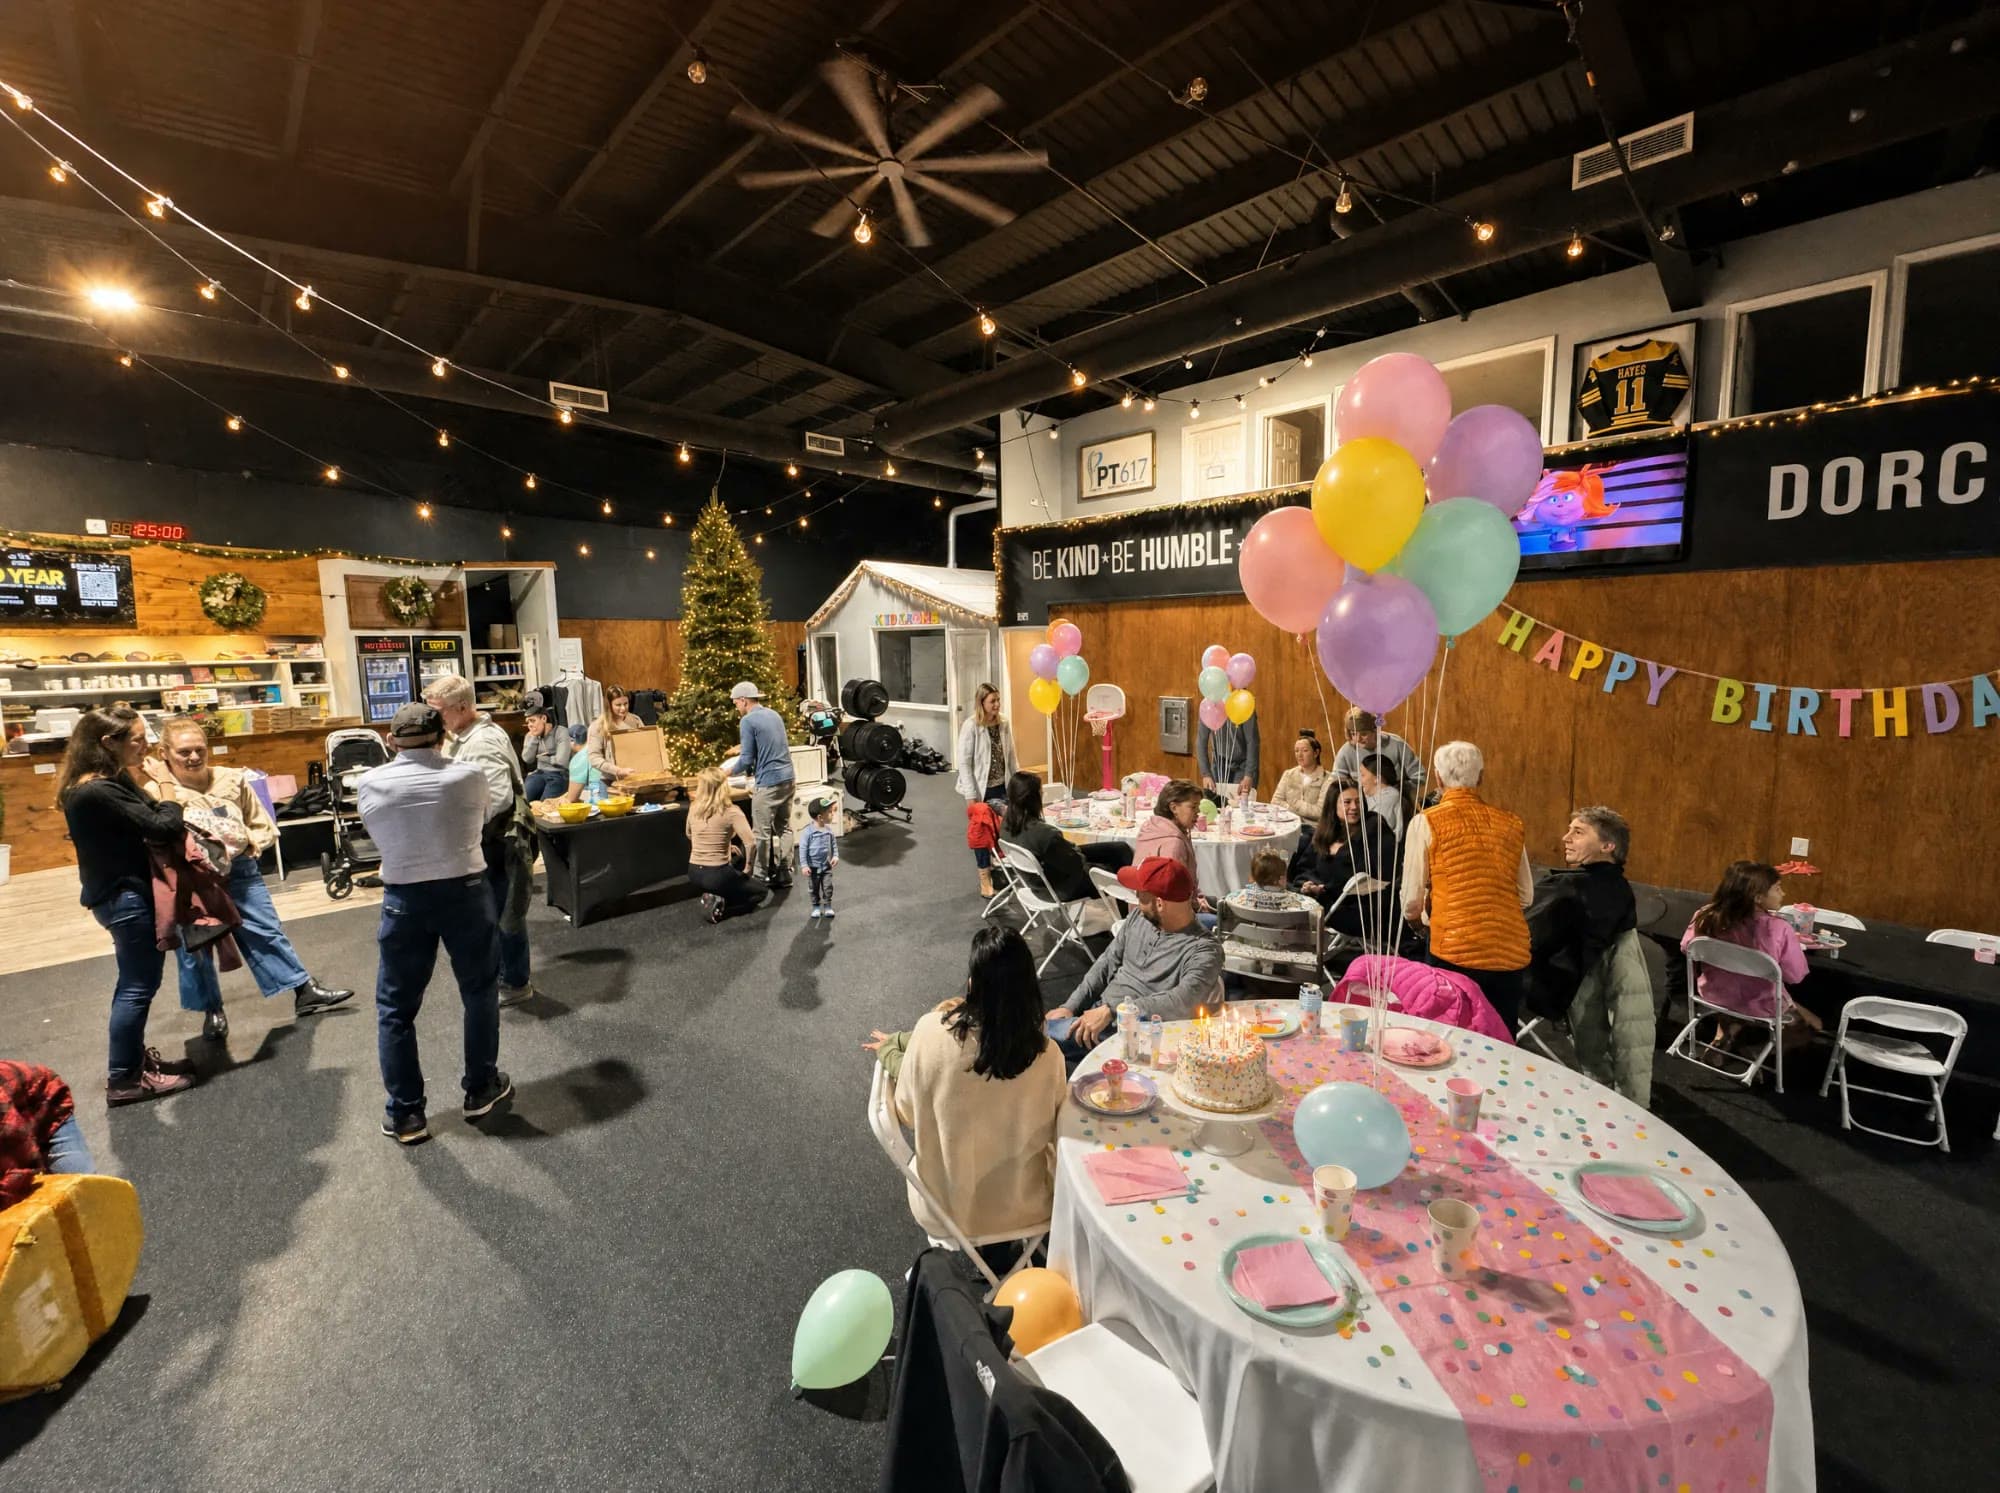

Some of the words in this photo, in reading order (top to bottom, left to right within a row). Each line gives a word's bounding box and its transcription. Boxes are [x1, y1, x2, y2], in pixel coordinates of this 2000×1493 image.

[1617, 364, 1647, 379] HAYES
[1614, 377, 1646, 415] 11
[1032, 550, 1053, 580] BE
[1056, 544, 1100, 578] KIND
[1111, 539, 1136, 573] BE
[1140, 528, 1234, 571] HUMBLE
[8, 568, 66, 585] YEAR
[1497, 610, 1678, 706] HAPPY
[1711, 673, 2000, 737] BIRTHDA
